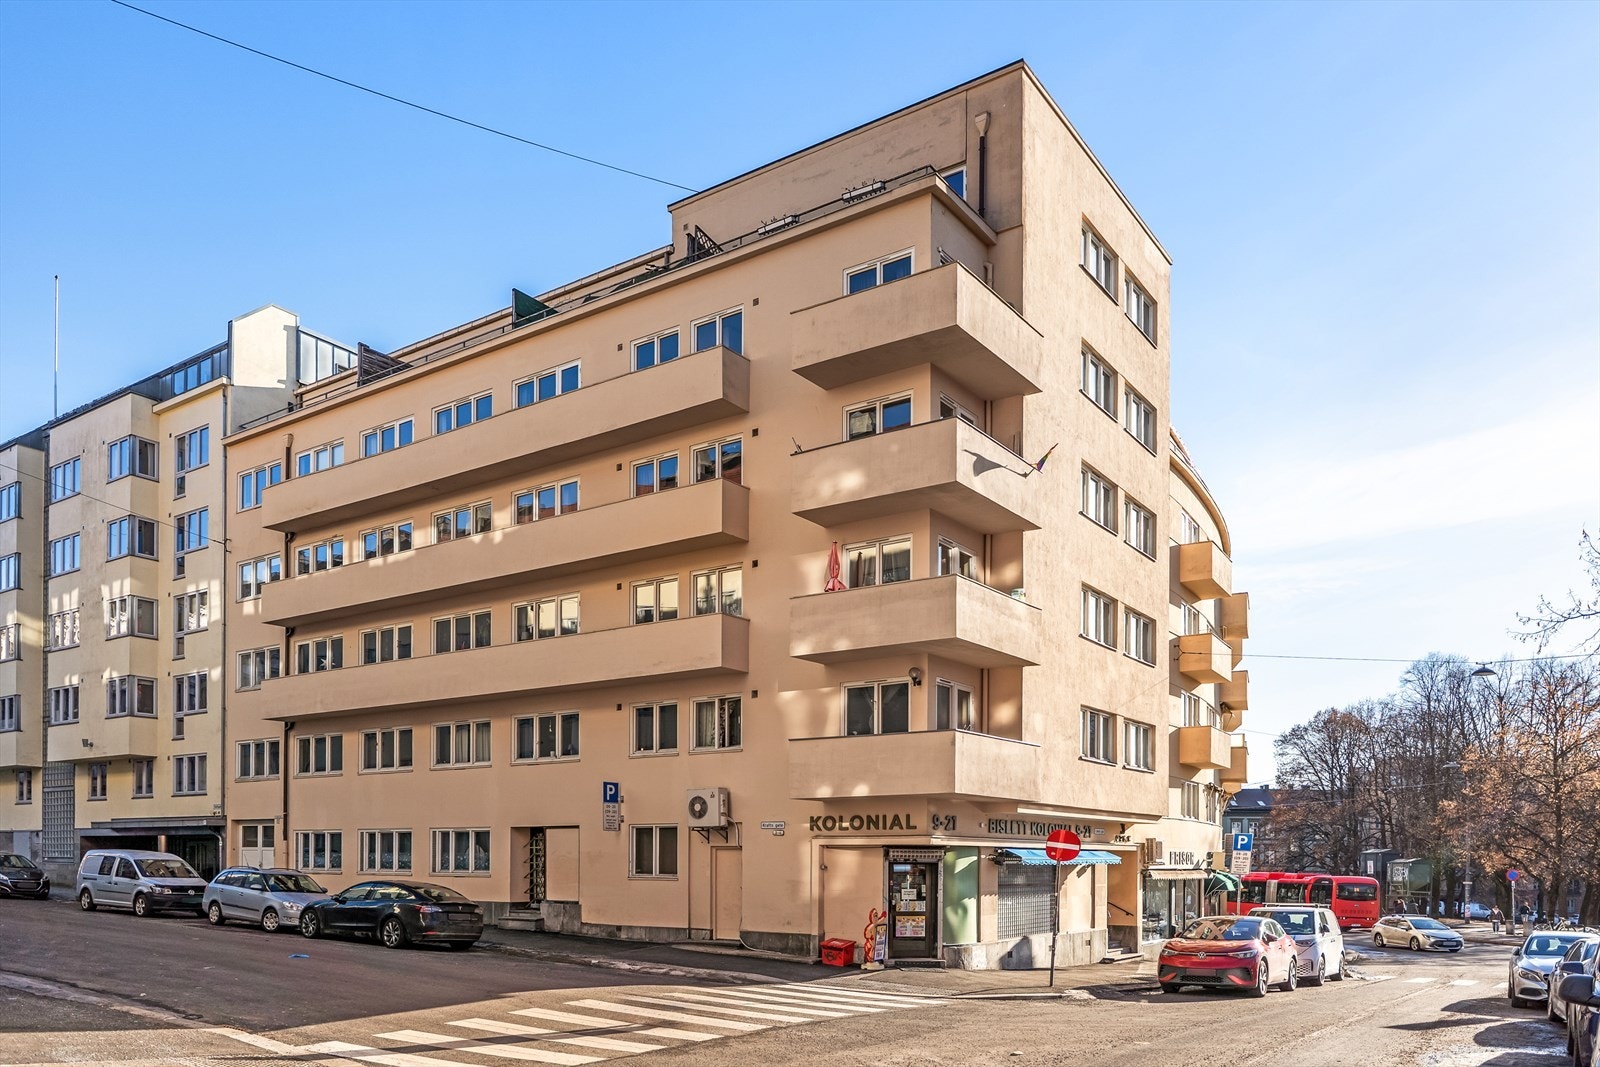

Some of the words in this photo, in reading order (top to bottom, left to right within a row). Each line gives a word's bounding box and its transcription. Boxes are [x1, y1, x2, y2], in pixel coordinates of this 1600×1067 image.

[606, 784, 616, 800] P
[809, 813, 918, 832] KOLONIAL
[988, 818, 1028, 836] BISLETT
[1237, 835, 1249, 849] P
